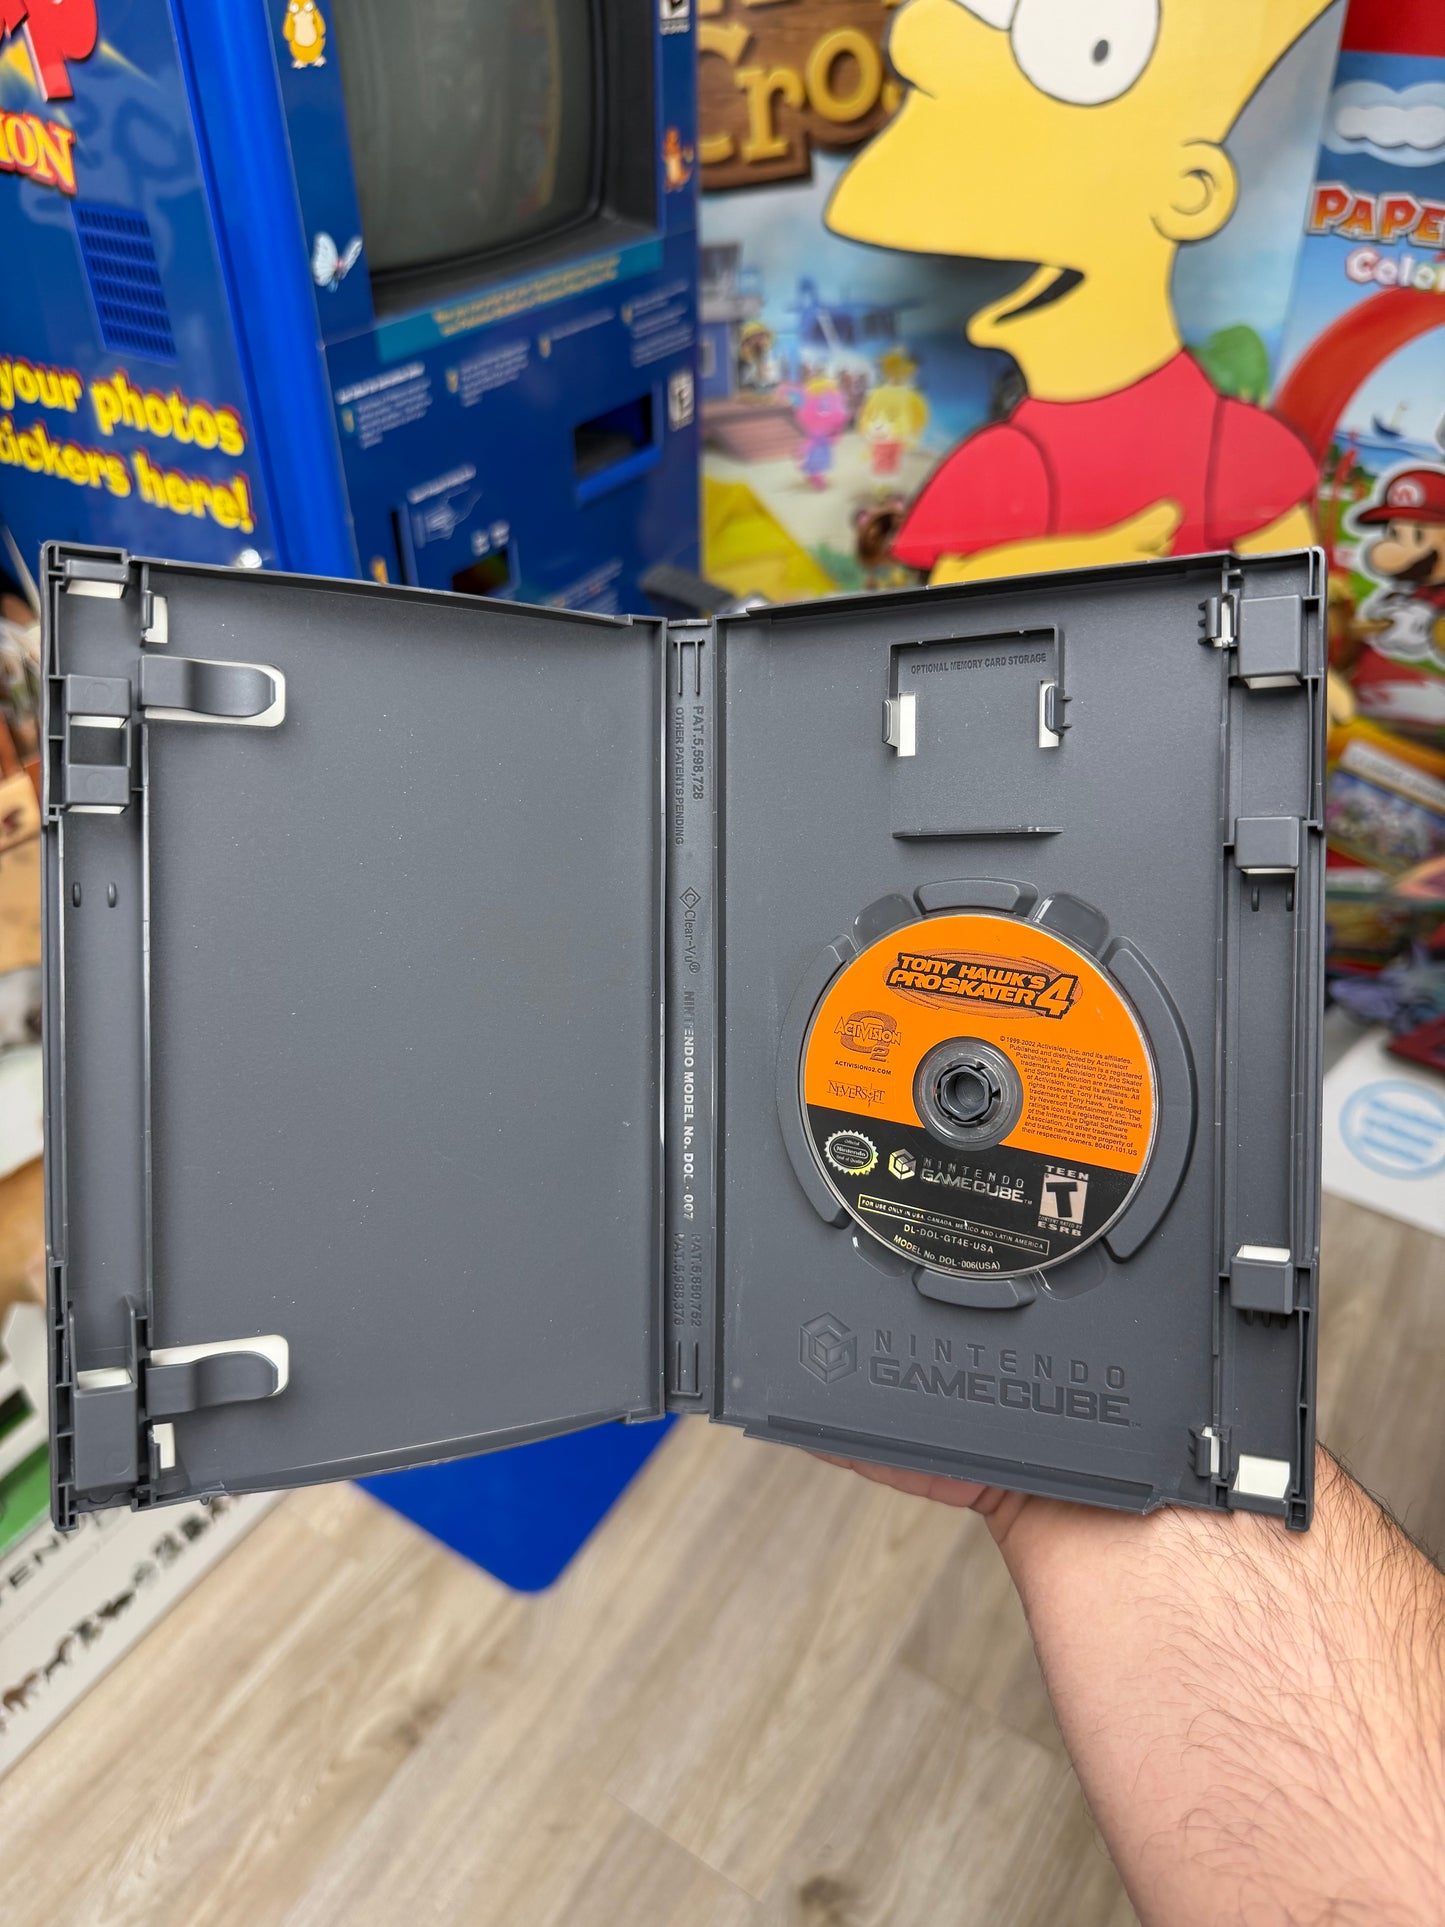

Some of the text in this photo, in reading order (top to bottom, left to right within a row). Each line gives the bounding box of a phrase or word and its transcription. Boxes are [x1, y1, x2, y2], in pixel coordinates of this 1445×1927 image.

[697, 22, 900, 164] Cro
[1306, 183, 1445, 249] PAPE
[91, 367, 246, 456] photos
[132, 446, 256, 534] here!
[911, 652, 1047, 675] OPTIONAL MEMORY CARD STORAGE
[675, 707, 685, 846] OTHER PATENTS PENDING
[900, 955, 1047, 990] TONY HAWK'S
[1032, 976, 1075, 1017] 4
[684, 990, 695, 1068] NINTENDO
[1009, 1043, 1038, 1054] Published
[1052, 1051, 1085, 1062] distributed
[1104, 1055, 1132, 1064] affiliates.
[1020, 1059, 1050, 1069] trademark
[1065, 1067, 1095, 1078] Activision
[1121, 1077, 1142, 1086] Skater
[1036, 1068, 1056, 1077] Sports
[1058, 1072, 1090, 1084] Revolution
[1103, 1081, 1139, 1093] trademarks
[1065, 1061, 1096, 1071] Activision
[1110, 1070, 1142, 1079] registered
[684, 1072, 694, 1123] MODEL
[1029, 1088, 1059, 1098] trademark
[1068, 1095, 1084, 1104] Tony
[1107, 1102, 1141, 1114] Developed
[1047, 1086, 1074, 1094] reserved.
[1077, 1090, 1092, 1099] Tony
[1093, 1093, 1110, 1101] Hawk
[1101, 1088, 1129, 1098] affiliates.
[1028, 1102, 1049, 1110] ratings
[1050, 1105, 1064, 1113] icon
[1077, 1112, 1108, 1122] registered
[1110, 1117, 1142, 1128] trademark
[1038, 1096, 1067, 1107] Neversoft
[1128, 1113, 1140, 1121] The
[1045, 1111, 1077, 1122] Interactive
[1079, 1117, 1098, 1126] Digital
[1100, 1121, 1127, 1132] Software
[684, 1126, 694, 1150] No.
[1021, 1126, 1035, 1134] their
[1036, 1130, 1067, 1141] respective
[1037, 1123, 1052, 1131] trade
[1053, 1127, 1074, 1135] names
[1098, 1136, 1124, 1147] property
[1074, 1124, 1090, 1132] other
[1092, 1127, 1127, 1139] trademarks
[836, 1145, 865, 1156] Nintendo
[922, 1155, 1025, 1189] NINTENDO
[1044, 1165, 1089, 1180] TEEN
[1046, 1182, 1078, 1218] T
[861, 1198, 873, 1206] FOR
[874, 1202, 886, 1210] USE
[887, 1205, 902, 1214] ONLY
[954, 1222, 978, 1233] MEXICO
[980, 1229, 993, 1237] AND
[995, 1232, 1012, 1242] LATIN
[1014, 1237, 1043, 1250] AMERICA
[1037, 1220, 1082, 1237] ESRB
[892, 1234, 921, 1255] MODEL
[923, 1250, 936, 1260] No.
[903, 1223, 993, 1254] DL-DOL-GT4E-USA
[873, 1329, 1126, 1391] NINTENDO
